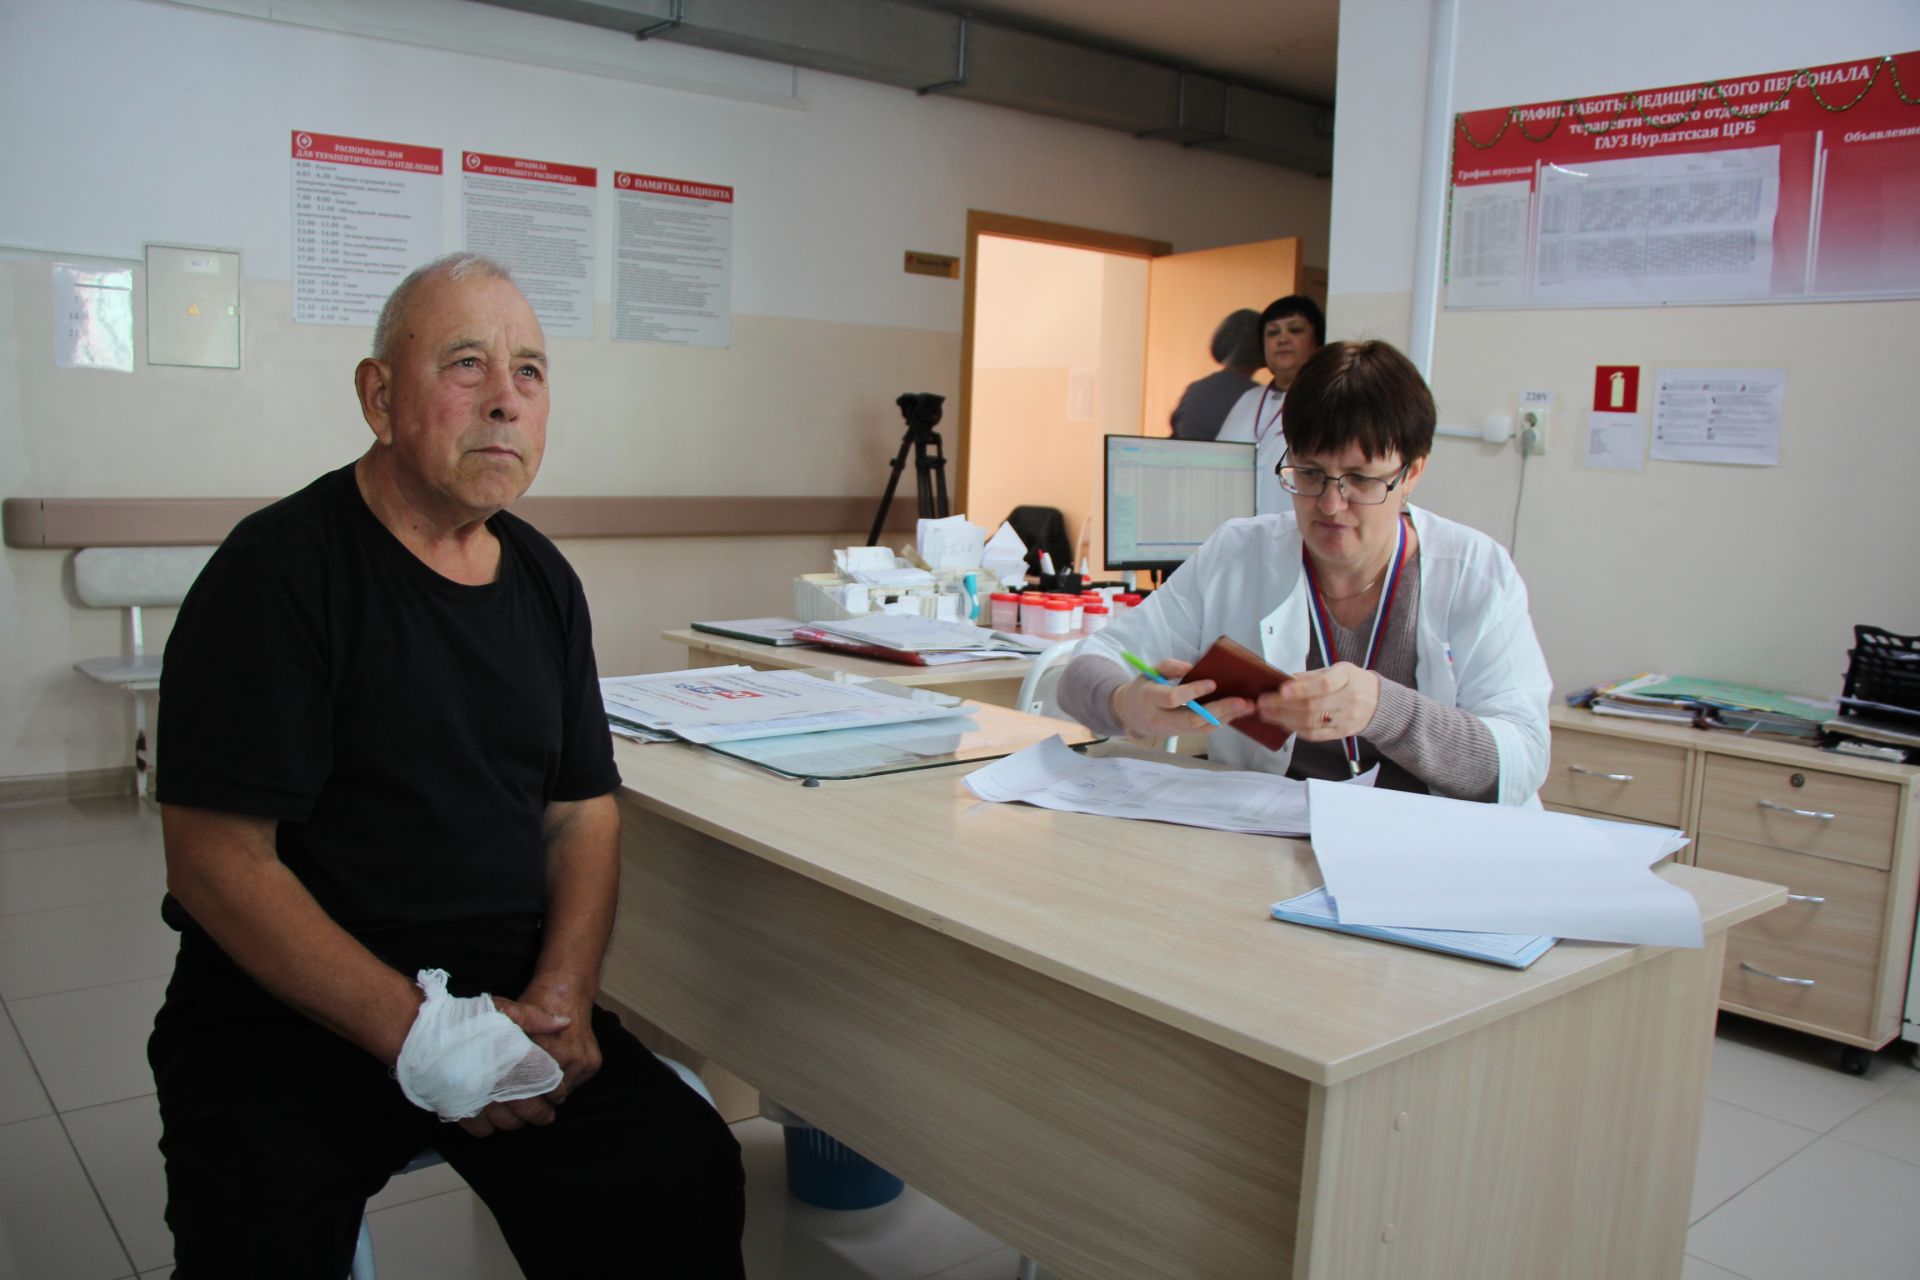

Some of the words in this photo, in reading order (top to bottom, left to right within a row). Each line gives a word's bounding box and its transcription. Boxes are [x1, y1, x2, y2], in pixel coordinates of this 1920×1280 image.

[1594, 135, 1629, 150] ГАУЗ
[1631, 127, 1719, 148] Нурлатская
[1722, 121, 1756, 138] ЦРБ
[296, 150, 313, 158] ДЛЯ
[315, 152, 393, 168] ТЕРАПЕВТИЧЕСКОГО
[395, 161, 439, 172] ОТДЕЛЕНИЯ
[335, 144, 385, 157] РАСПОРЯДОК
[387, 151, 403, 159] ДНЯ
[483, 166, 533, 178] ВНУТРЕННЕГО
[534, 173, 577, 183] РАСПОРЯДКА
[515, 161, 547, 170] ПРАВИЛА
[635, 178, 681, 194] ПАМЯТКА
[682, 185, 730, 199] ПАЦИЕНТА
